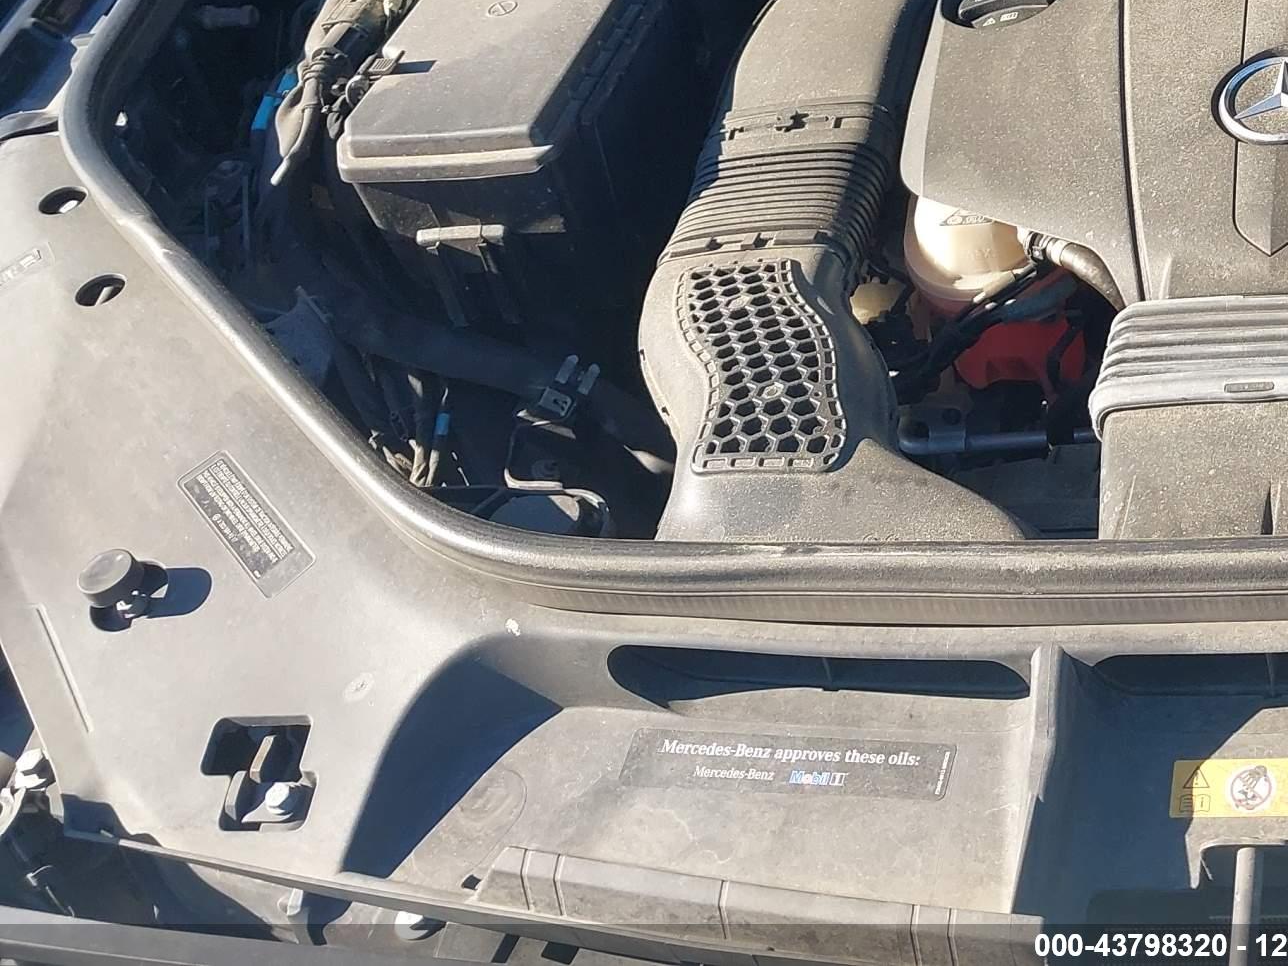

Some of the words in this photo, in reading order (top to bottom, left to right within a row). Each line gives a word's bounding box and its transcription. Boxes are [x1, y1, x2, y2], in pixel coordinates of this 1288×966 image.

[660, 739, 771, 760] Mercedes-Benz
[774, 749, 841, 763] approves
[845, 750, 886, 765] these
[888, 752, 921, 766] oils:
[693, 765, 775, 781] Mercedes-Benz
